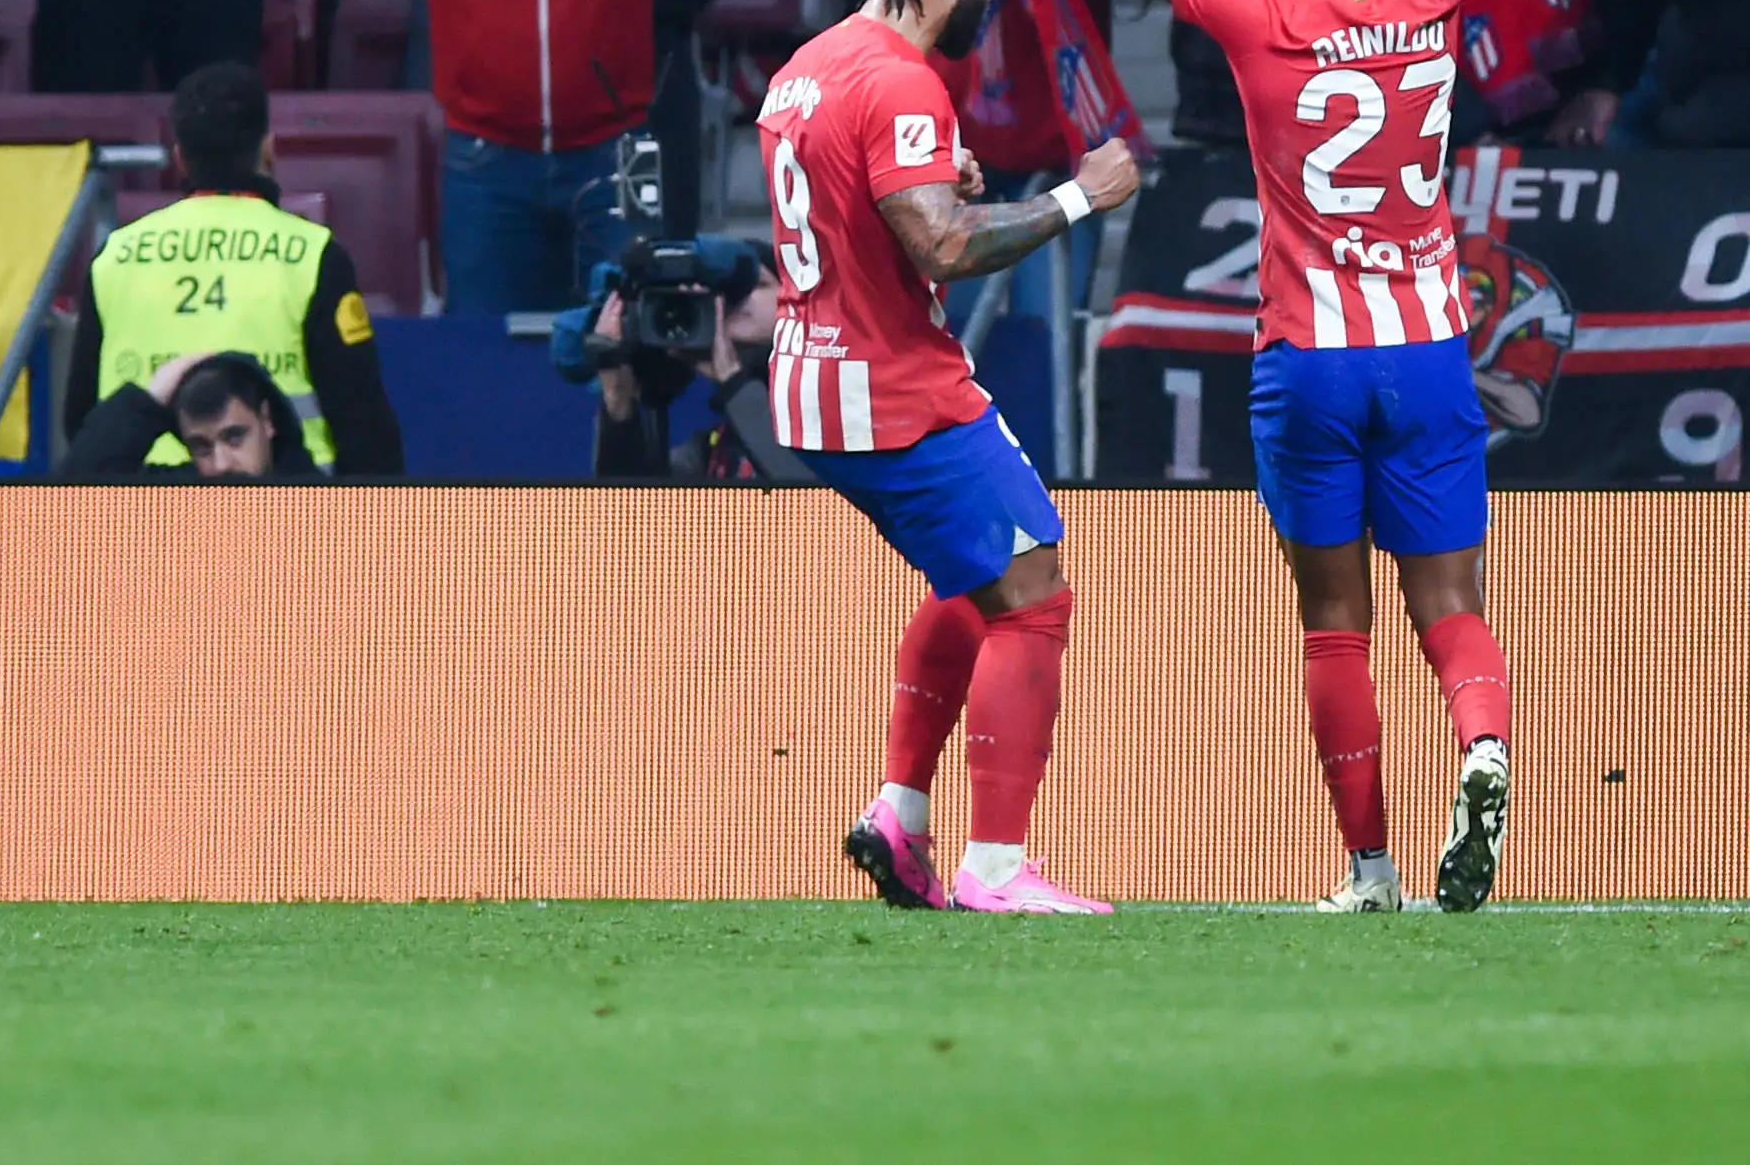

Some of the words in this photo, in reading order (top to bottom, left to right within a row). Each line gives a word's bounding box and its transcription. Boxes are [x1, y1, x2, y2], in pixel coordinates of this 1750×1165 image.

[1311, 20, 1446, 69] REINILDO
[1295, 53, 1457, 215] 23
[773, 137, 822, 292] 9
[115, 227, 309, 265] SEGURIDAD
[1332, 226, 1405, 272] ria
[174, 274, 227, 315] 24
[1659, 387, 1744, 484] 9
